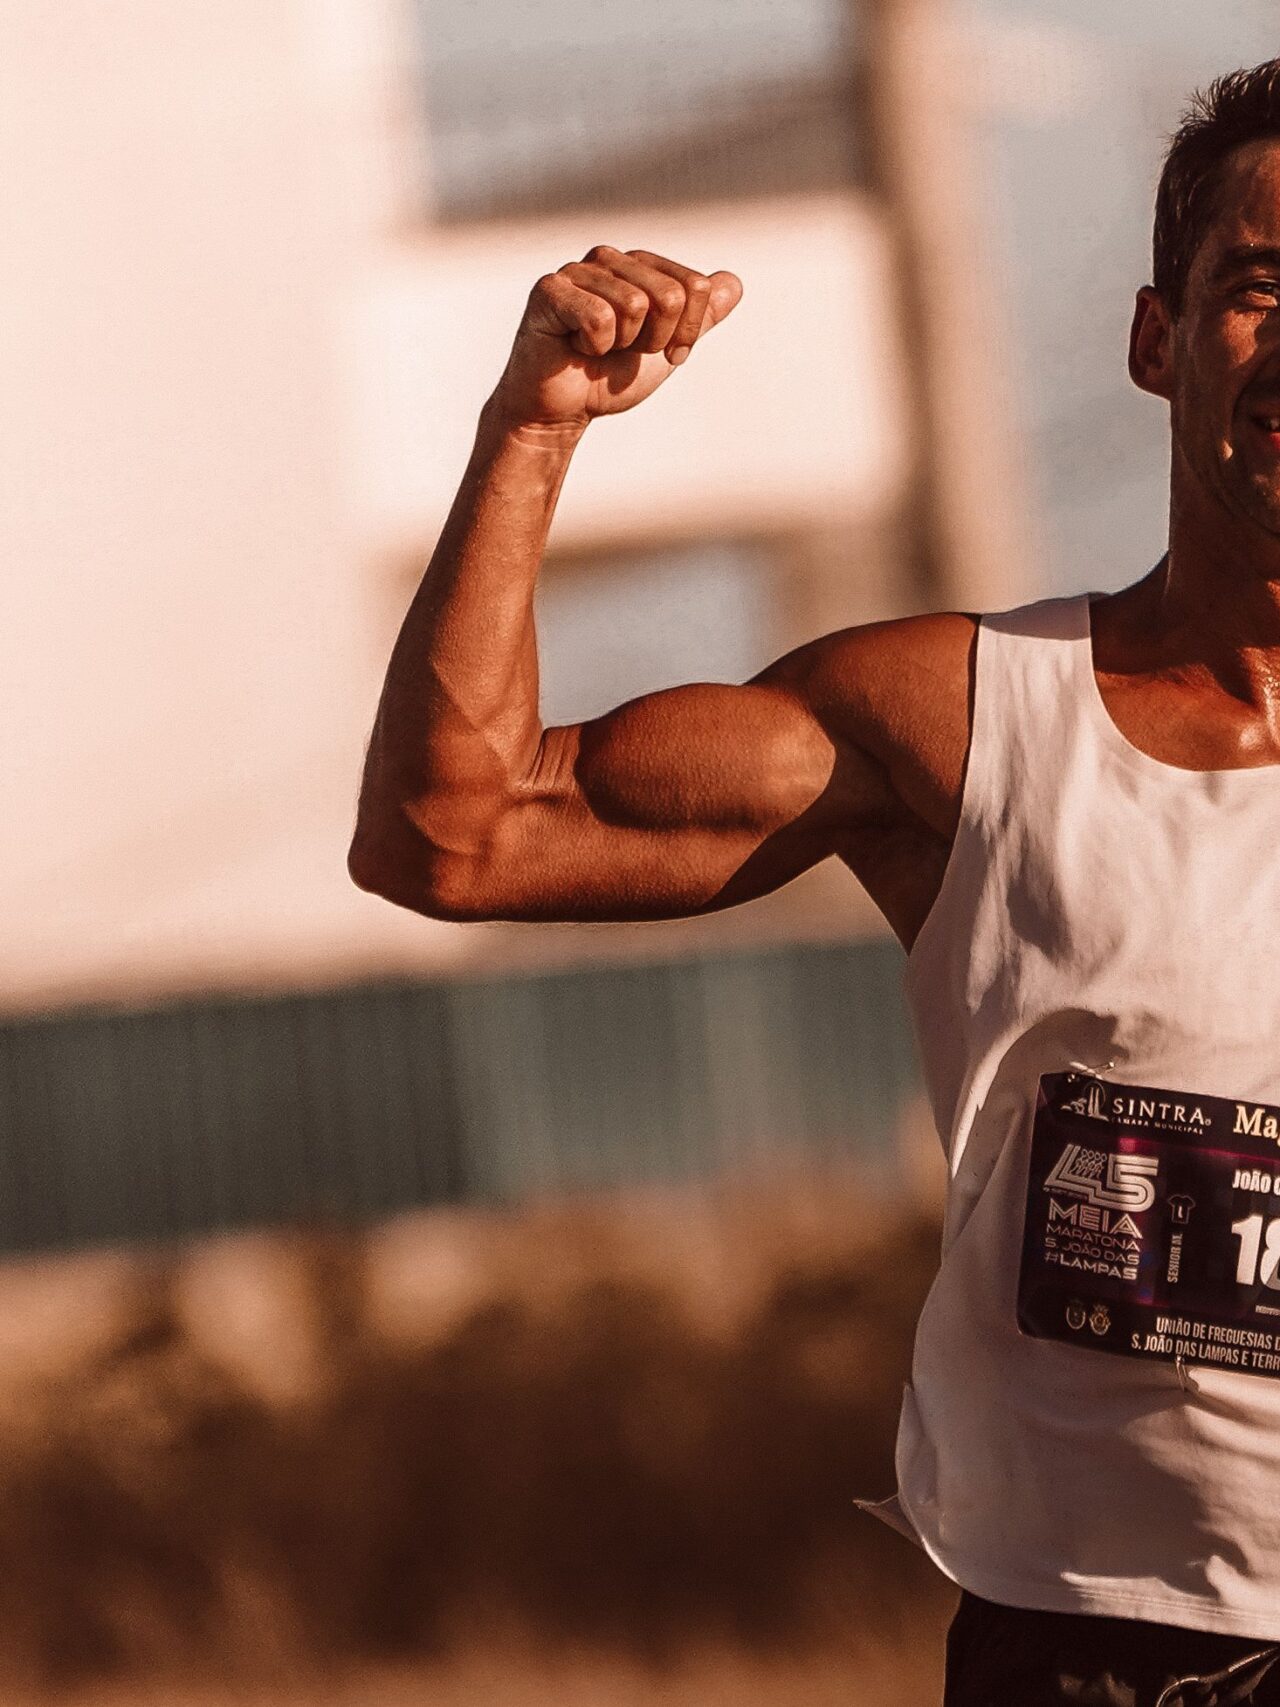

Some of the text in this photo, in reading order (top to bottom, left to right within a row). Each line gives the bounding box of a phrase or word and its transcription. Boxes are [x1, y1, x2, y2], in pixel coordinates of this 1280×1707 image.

[1112, 1098, 1204, 1126] SINTRA
[1043, 1143, 1159, 1212] 45
[1232, 1169, 1272, 1194] JOÃO
[1049, 1198, 1143, 1239] MEIA
[1046, 1223, 1141, 1252] MARATONA
[1044, 1252, 1138, 1280] #LAMPAS
[1062, 1242, 1101, 1258] JOÃO
[1104, 1251, 1140, 1265] DAS
[1156, 1316, 1191, 1337] UNIÃO
[1193, 1322, 1206, 1340] DE
[1208, 1325, 1272, 1350] FREGUESIAS
[1131, 1333, 1141, 1350] S.
[1144, 1335, 1173, 1354] JOÃO
[1175, 1340, 1197, 1358] DAS
[1198, 1343, 1239, 1366] LAMPAS
[1241, 1349, 1249, 1366] E
